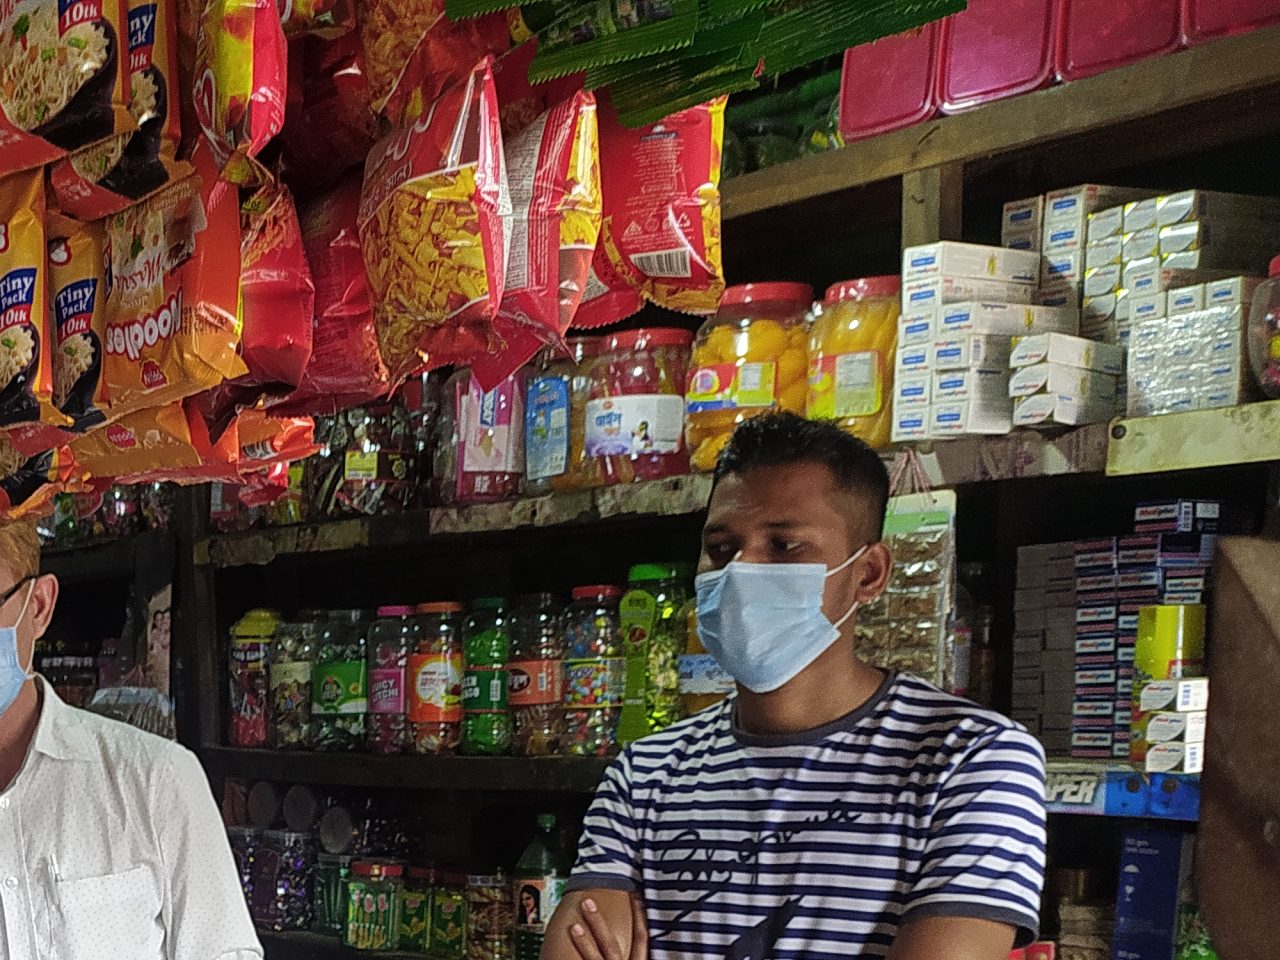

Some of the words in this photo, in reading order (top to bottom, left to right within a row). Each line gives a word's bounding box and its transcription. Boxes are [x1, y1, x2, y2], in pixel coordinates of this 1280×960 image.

[63, 1, 98, 27] 10tk
[1, 291, 27, 309] Pack
[58, 286, 95, 307] Tiny
[0, 308, 27, 329] 10tk
[62, 302, 87, 319] Pack
[62, 318, 88, 337] 10tk
[106, 287, 183, 360] Noodles
